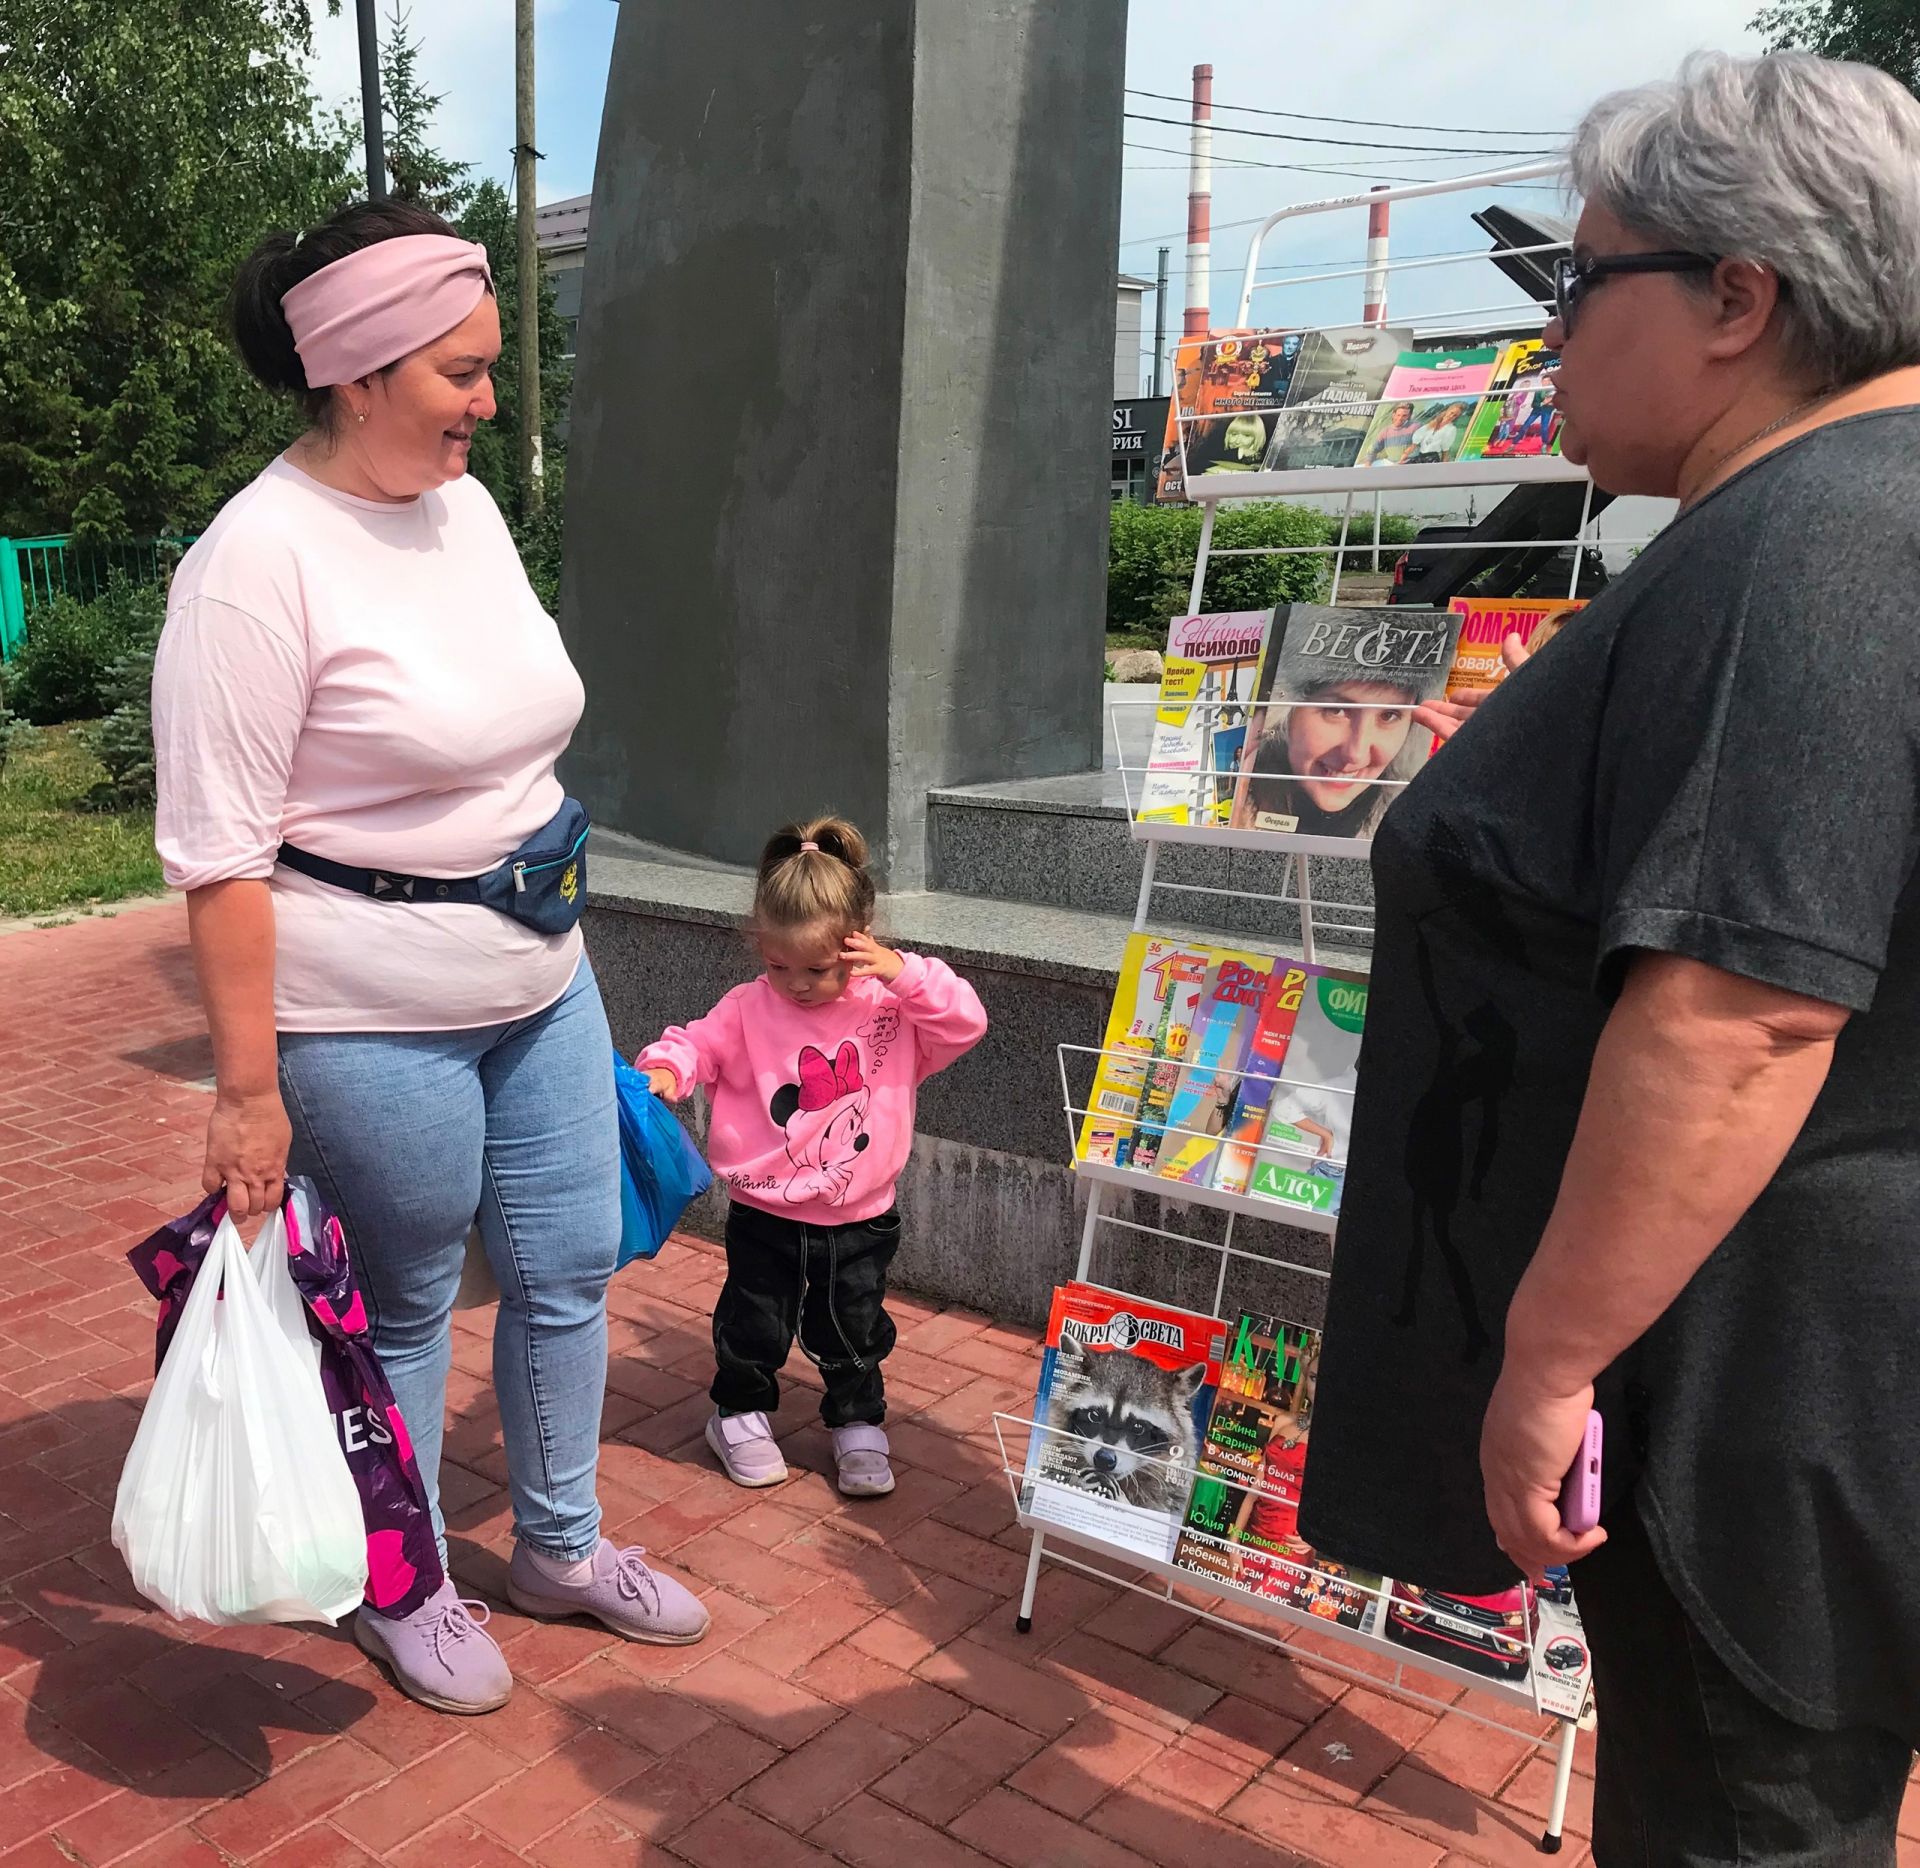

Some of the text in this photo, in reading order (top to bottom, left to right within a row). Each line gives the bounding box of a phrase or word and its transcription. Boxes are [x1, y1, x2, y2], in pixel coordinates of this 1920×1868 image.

[1215, 398, 1242, 406] МНОГО
[1244, 398, 1254, 406] НЕ
[1322, 389, 1367, 402] ГАДЮКА
[1113, 436, 1142, 450] РИЯ
[1184, 639, 1260, 658] ПСИХОЛО
[1300, 621, 1448, 667] ВЕСТА
[1167, 667, 1195, 676] Пройди
[1452, 656, 1494, 671] овая
[1165, 678, 1184, 686] тест!
[1148, 942, 1161, 953] 36
[1170, 1033, 1188, 1046] 10
[728, 1169, 780, 1190] Minnie
[1064, 1319, 1182, 1348] ВОКРУГ СВЕТА
[1215, 1415, 1257, 1439] Полина
[1207, 1444, 1295, 1483] В любви я была
[1190, 1510, 1224, 1532] Юлия
[1178, 1559, 1292, 1606] с Кристиной Асмус
[1181, 1543, 1360, 1616] ребенка, а сам уже встречался
[1270, 1559, 1306, 1580] зачать
[1311, 1575, 1325, 1587] со
